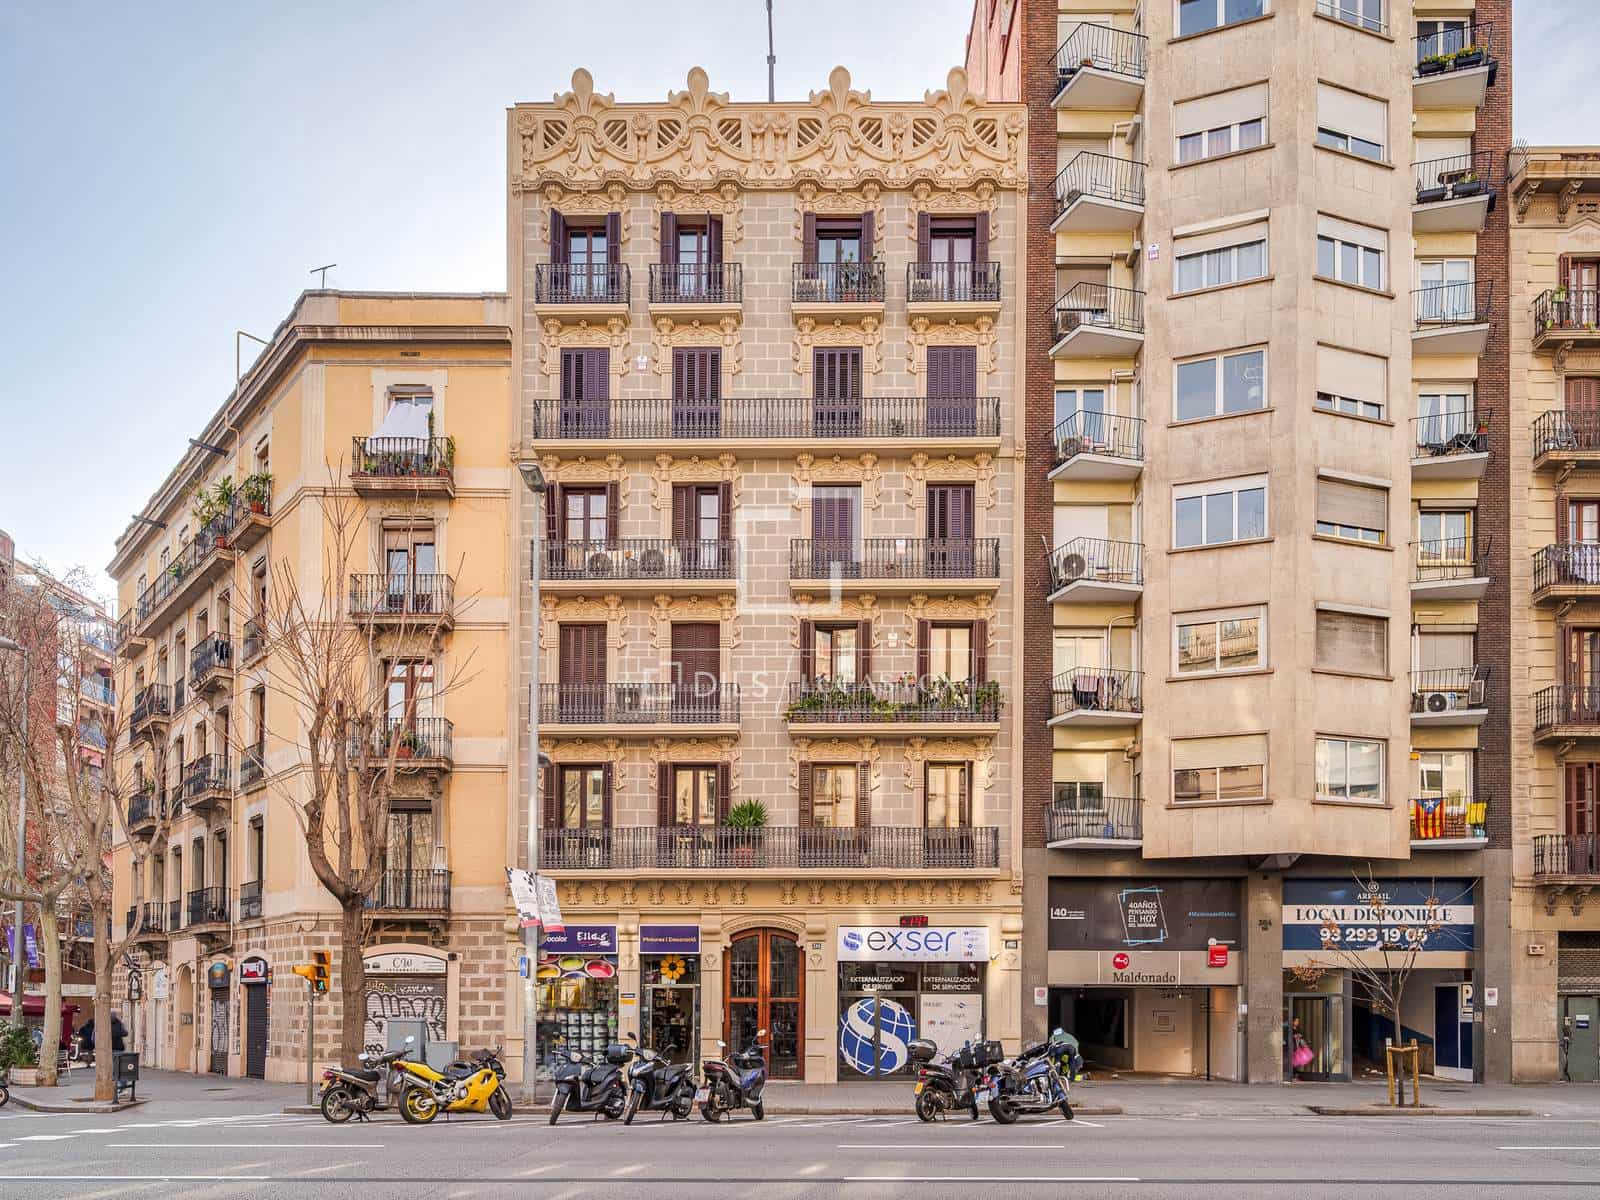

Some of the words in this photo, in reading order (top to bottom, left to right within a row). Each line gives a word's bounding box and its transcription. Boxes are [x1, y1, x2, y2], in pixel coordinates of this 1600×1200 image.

[1128, 915, 1136, 923] EL
[1139, 914, 1157, 923] HOY
[1296, 908, 1346, 921] LOCAL
[1354, 908, 1453, 921] DISPONIBLE
[867, 931, 957, 952] exser
[1320, 928, 1342, 942] 93
[1345, 928, 1378, 942] 293
[1382, 928, 1400, 942] 19
[1113, 971, 1176, 984] Maldonado
